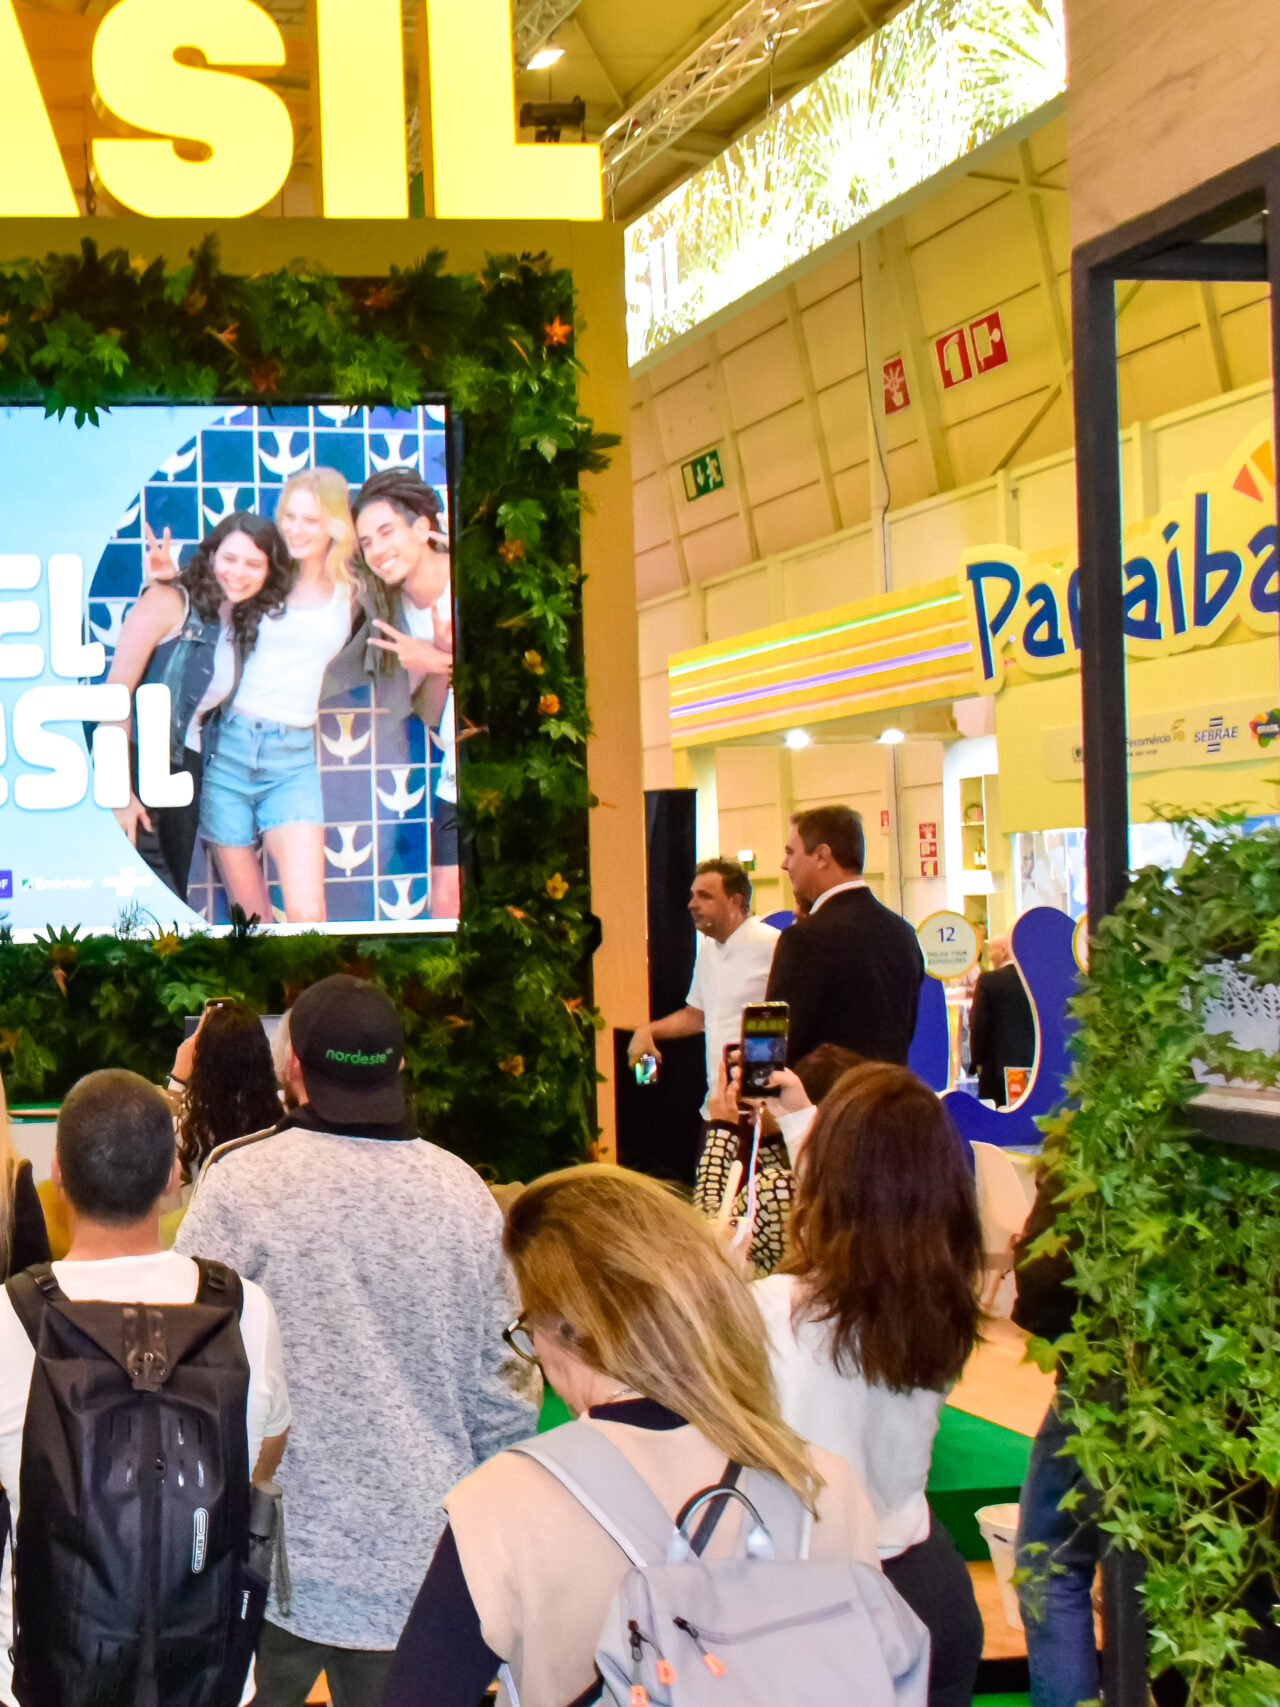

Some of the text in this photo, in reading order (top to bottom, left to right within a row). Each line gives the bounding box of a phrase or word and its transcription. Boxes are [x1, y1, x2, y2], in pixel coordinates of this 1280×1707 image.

[1194, 726, 1238, 743] SEBRAE
[936, 926, 957, 943] 12
[325, 1048, 388, 1065] nordeste
